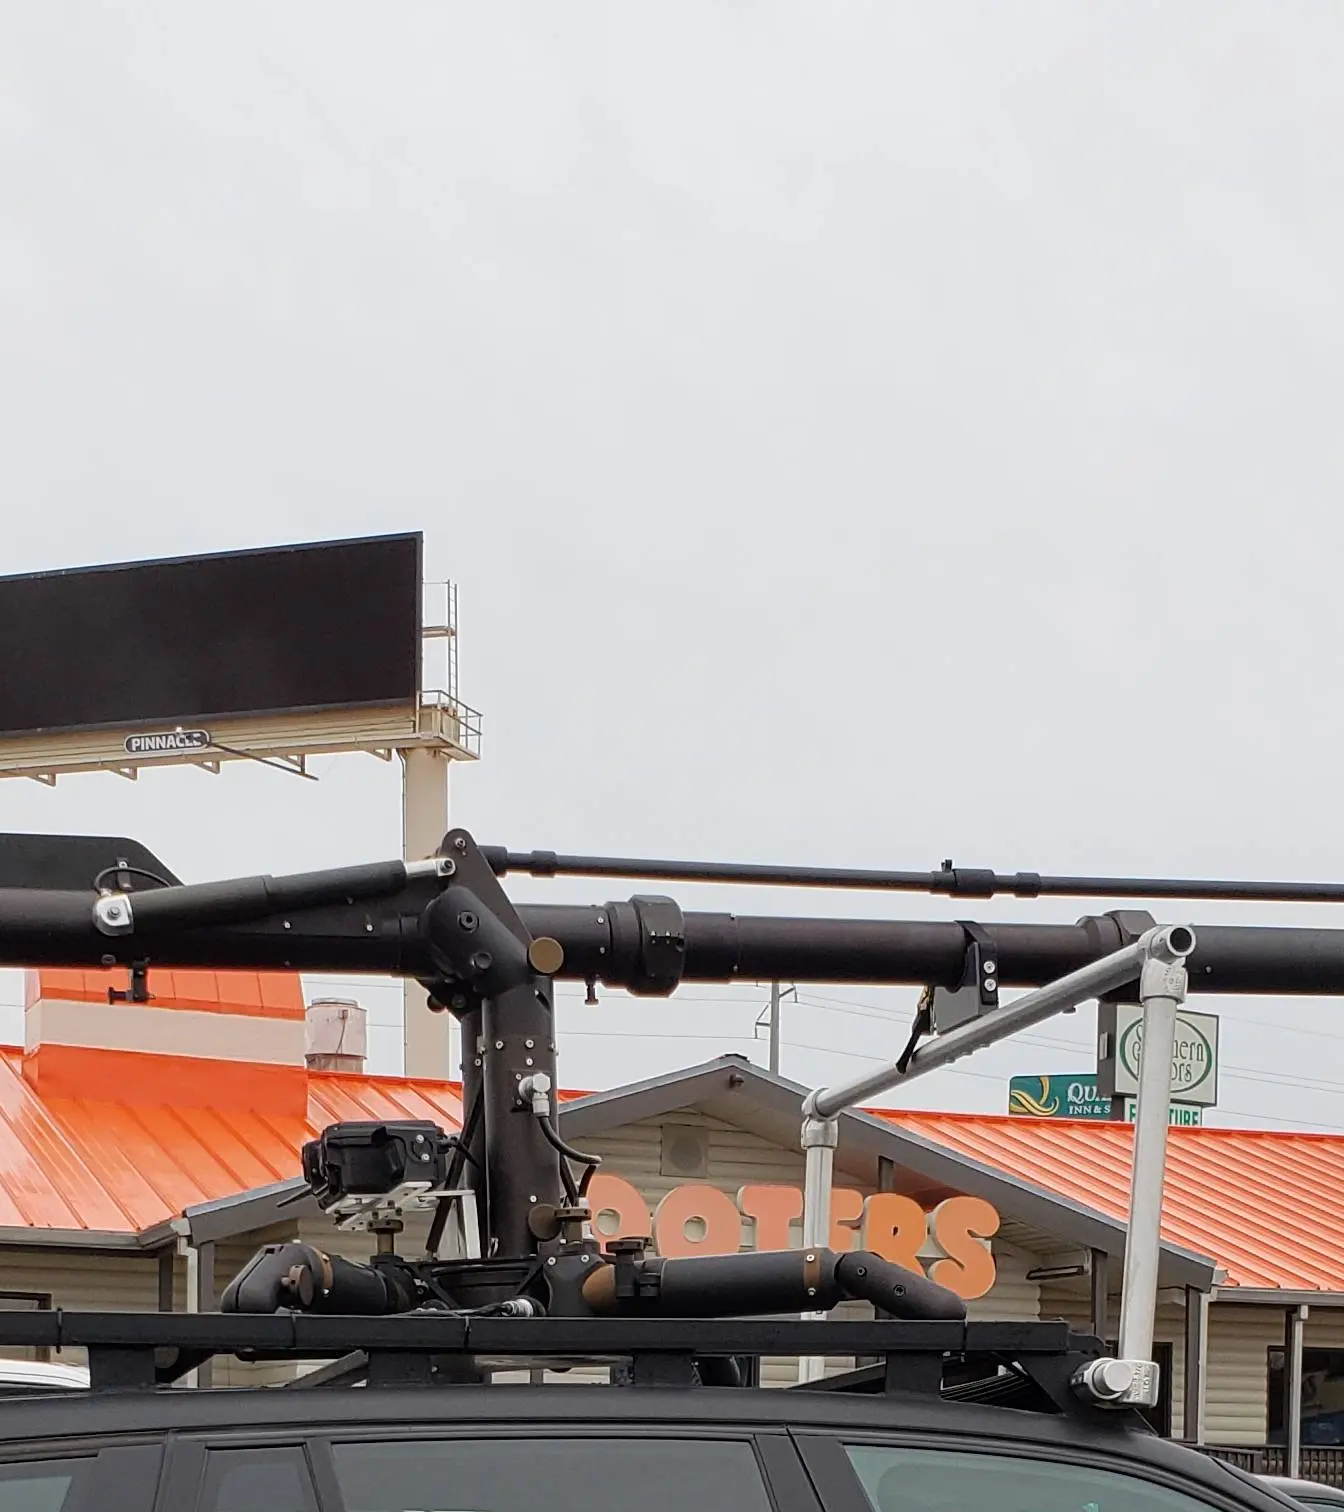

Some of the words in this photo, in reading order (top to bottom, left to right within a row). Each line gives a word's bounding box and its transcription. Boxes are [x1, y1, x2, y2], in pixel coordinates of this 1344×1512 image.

[131, 733, 202, 751] PINNACLE
[1068, 1105, 1092, 1115] INN
[1093, 1105, 1102, 1114] &
